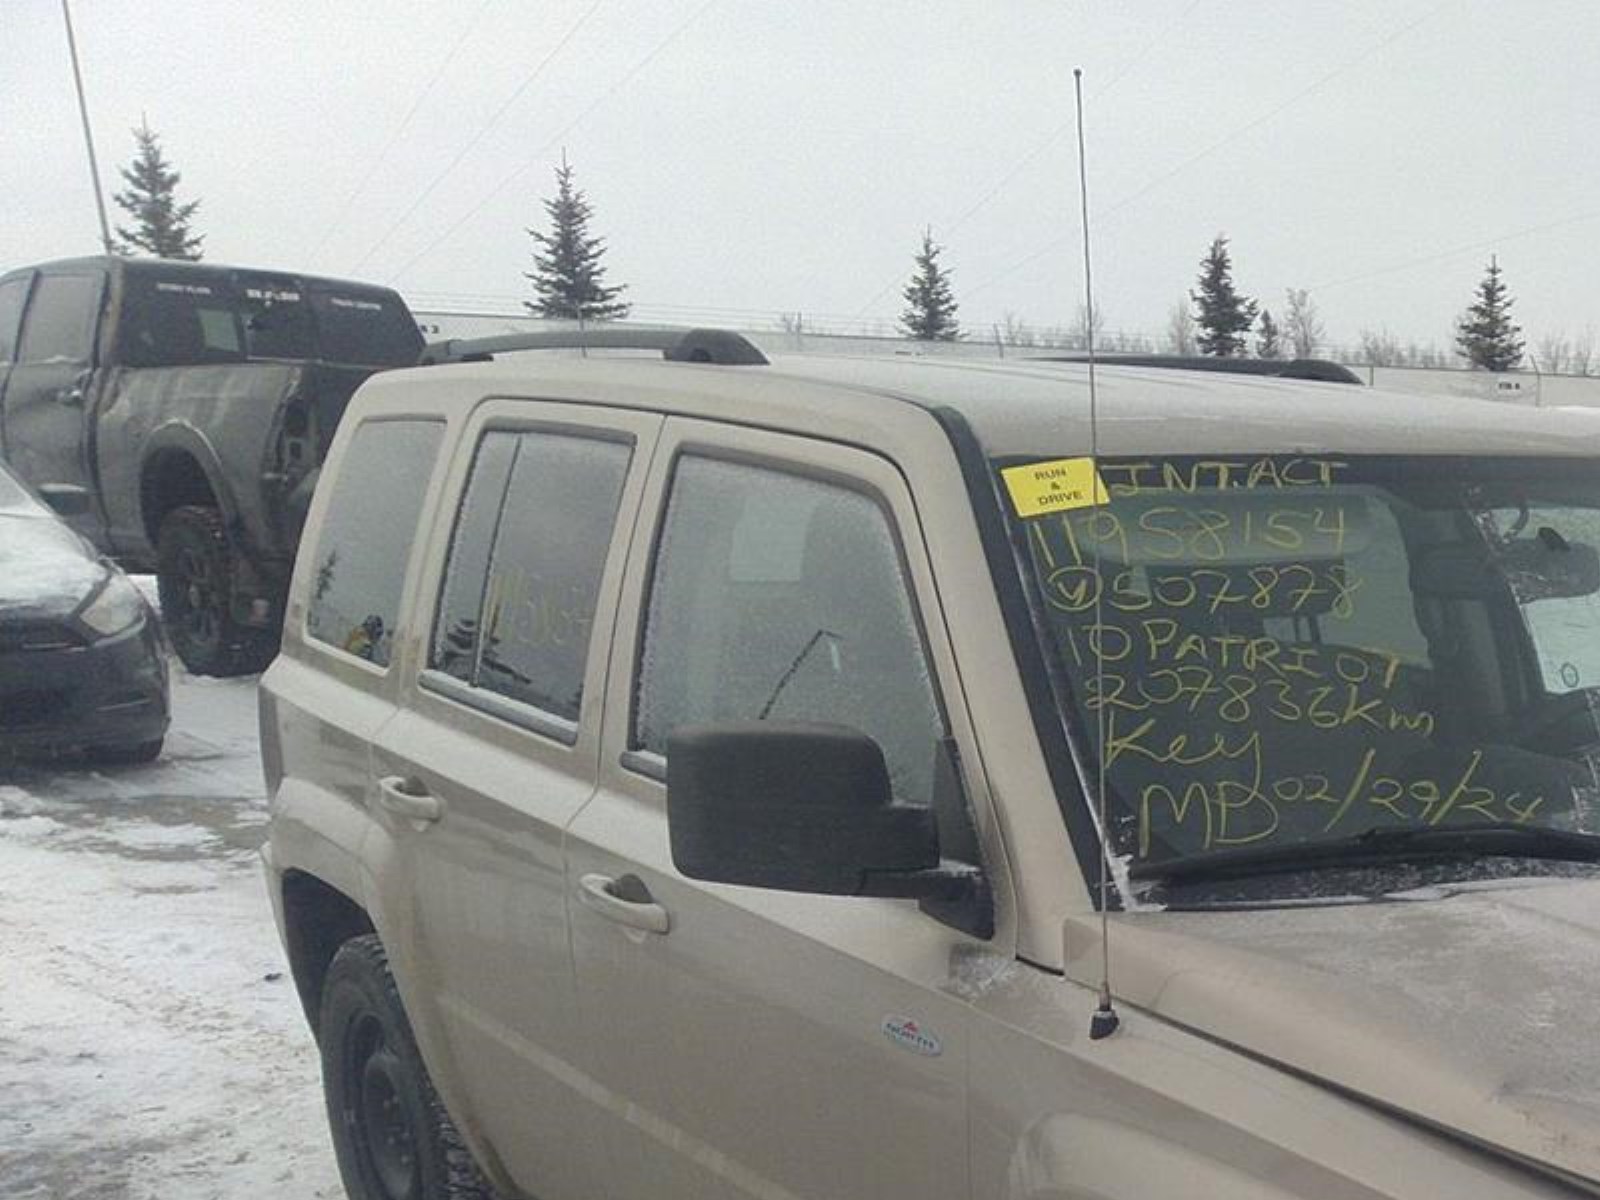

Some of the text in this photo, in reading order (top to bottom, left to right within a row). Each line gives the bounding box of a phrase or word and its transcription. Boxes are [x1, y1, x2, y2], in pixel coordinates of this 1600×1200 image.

[1034, 467, 1067, 480] RUN
[1037, 490, 1083, 506] DRIVE
[1033, 507, 1345, 568] 11958154
[1067, 618, 1400, 689] 10 PATRIOT
[1273, 748, 1543, 833] 02/29/24
